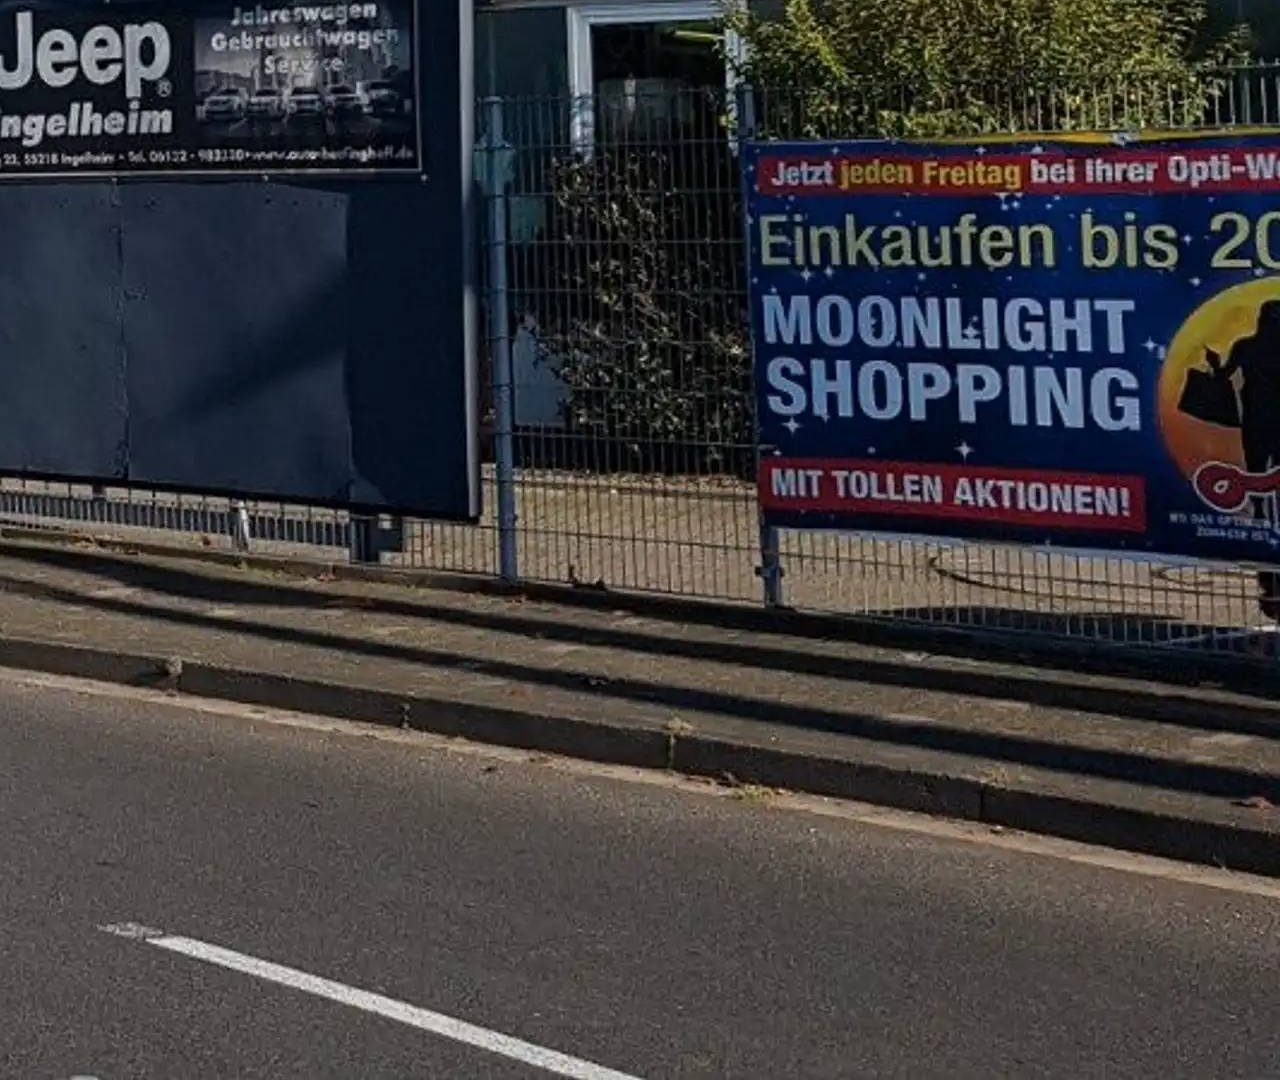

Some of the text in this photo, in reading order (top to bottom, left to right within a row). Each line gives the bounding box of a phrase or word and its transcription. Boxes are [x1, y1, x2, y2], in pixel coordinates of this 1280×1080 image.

[231, 3, 377, 25] Jahreswagen
[210, 29, 399, 52] Gebrauchtwagen
[264, 53, 344, 73] Service
[772, 153, 1280, 191] Jetzt jeden Freitag bei Ihrer Opti-W
[759, 213, 1055, 268] Einkaufen
[1081, 210, 1179, 269] bis
[762, 294, 1135, 354] MOONLIGHT
[766, 356, 1141, 431] SHOPPING
[771, 468, 1130, 517] MIT TOLLEN AKTIONEN!
